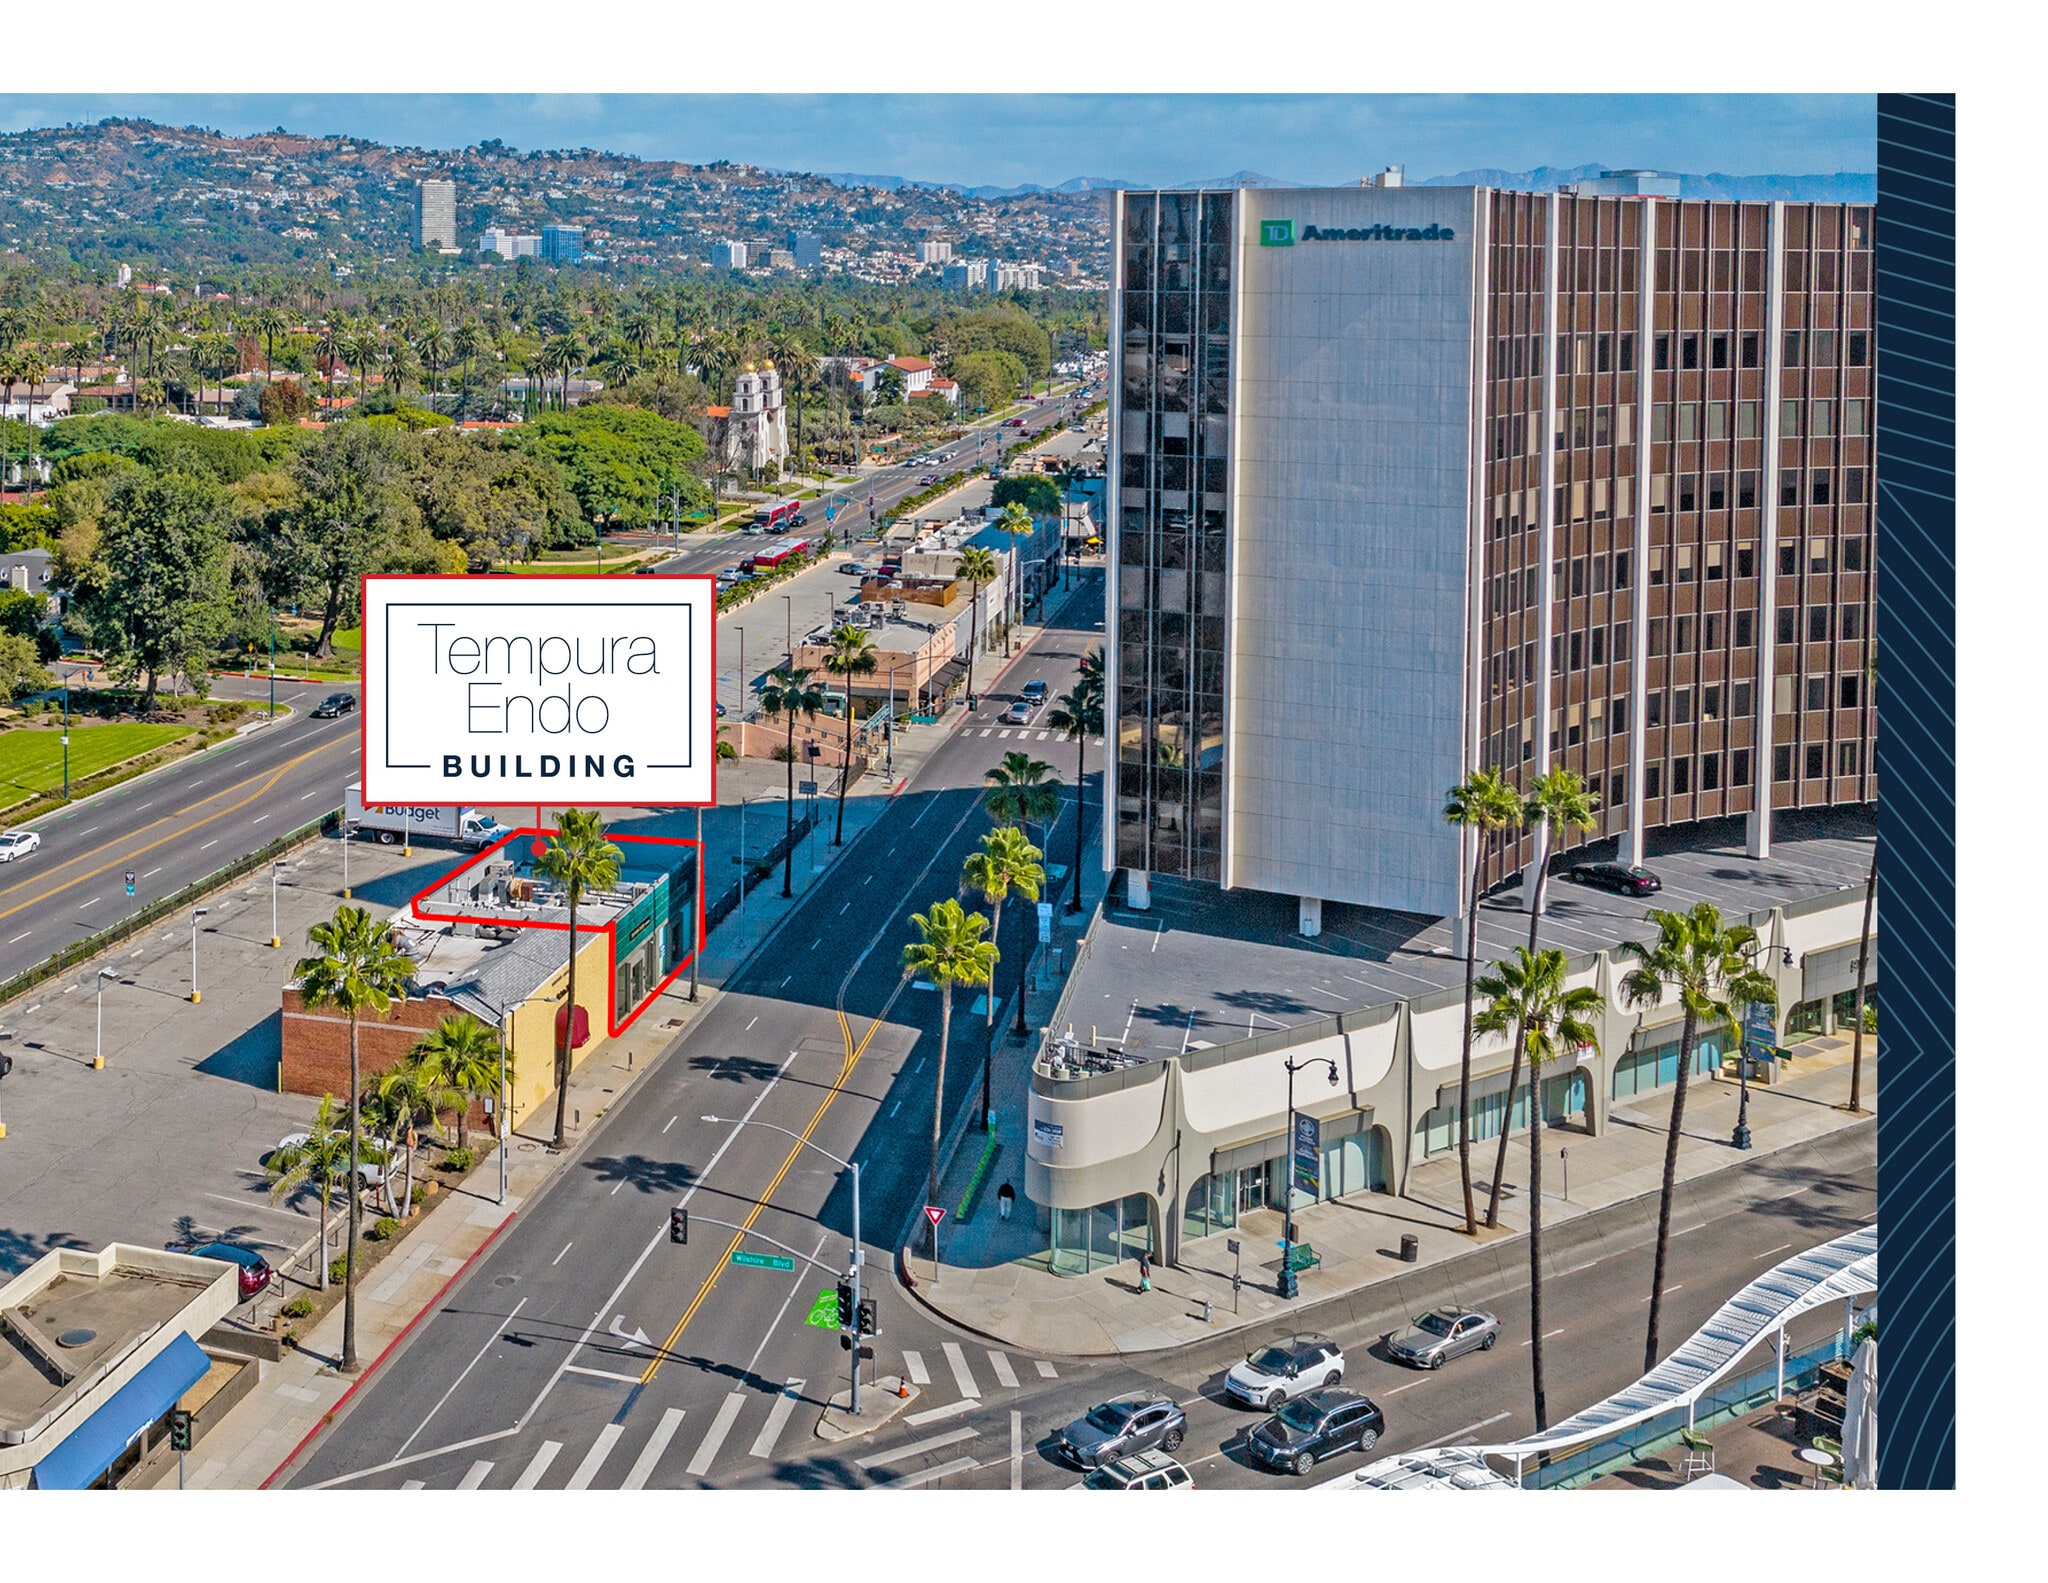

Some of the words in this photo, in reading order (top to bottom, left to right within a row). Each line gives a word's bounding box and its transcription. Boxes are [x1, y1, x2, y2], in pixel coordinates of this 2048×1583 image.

[1264, 225, 1290, 242] TD
[1302, 223, 1454, 241] Ameritrade
[385, 806, 441, 823] Budget
[736, 1254, 765, 1265] Wilshire
[772, 1258, 790, 1268] Blvd
